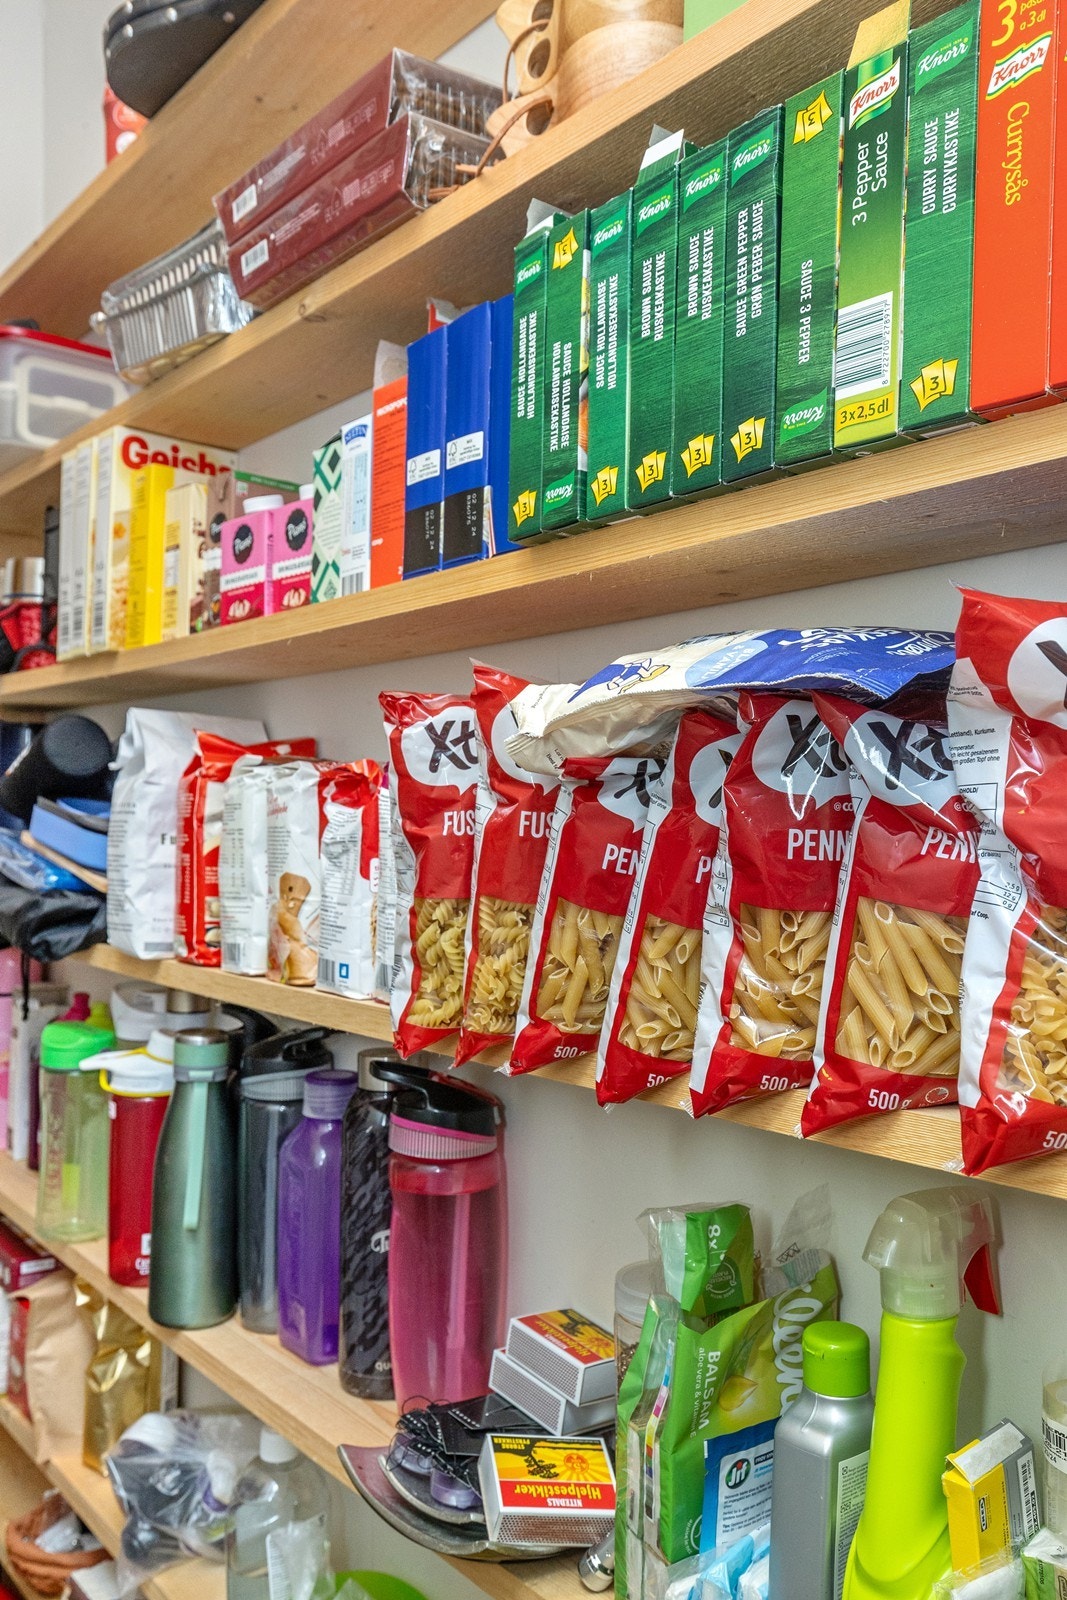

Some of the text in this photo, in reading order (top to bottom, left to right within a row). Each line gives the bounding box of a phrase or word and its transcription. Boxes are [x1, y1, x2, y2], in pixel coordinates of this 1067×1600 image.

[918, 43, 969, 76] Knorr
[993, 47, 1047, 87] Knorr
[851, 75, 898, 116] Knorr
[733, 142, 771, 171] Knorr
[871, 131, 888, 192] Sauce
[922, 117, 938, 215] CURRY SAUCE
[942, 107, 960, 214] CURRYKASTIKE
[1002, 101, 1030, 206] Currysås
[685, 170, 721, 198] Knorr
[852, 142, 873, 227] 3 Pepper
[638, 198, 671, 223] Knorr
[593, 223, 623, 247] Knorr
[517, 263, 542, 285] Knorr
[688, 233, 700, 318] BROWN SAUCE
[701, 226, 714, 321] RUSKEAKASTIKE
[735, 207, 749, 338] SAUCE GREEN PEPPER
[751, 200, 764, 319] GRØN PEBER SAUCE
[641, 257, 652, 339] BROWN SAUCE
[654, 251, 666, 342] RUSKEAKASTIKE
[798, 259, 813, 365] SAUCE 3 PEPPER
[596, 279, 606, 389] SAUCE HOLLANDAISE
[608, 273, 618, 390] HOLLANDAISEKASTIKE
[518, 315, 527, 418] SAUCE HOLLANDAISE
[527, 310, 537, 419] HOLLANDAISEKASTIKE
[550, 341, 561, 453] HOLLANDAISEKASTIKE
[561, 342, 572, 448] SAUCE HOLLANDAISE
[930, 375, 939, 391] 3
[784, 404, 825, 426] Knorr
[694, 448, 701, 461] 3
[745, 432, 752, 445] 3
[602, 479, 608, 491] 3
[648, 464, 654, 477] 3
[546, 483, 574, 500] Knorr
[442, 810, 476, 836] FUS
[602, 842, 641, 876] PEN
[787, 828, 851, 861] PENN
[920, 826, 979, 864] PENN
[553, 1046, 578, 1059] 500
[760, 1075, 788, 1091] 500
[867, 1088, 900, 1111] 500
[697, 1347, 705, 1368] aloe
[695, 1368, 703, 1389] vera
[698, 1351, 721, 1430] BALSAM
[728, 1460, 748, 1486] Jif
[514, 1483, 602, 1499] Hjelpestikker
[546, 1497, 583, 1507] NITEDALS
